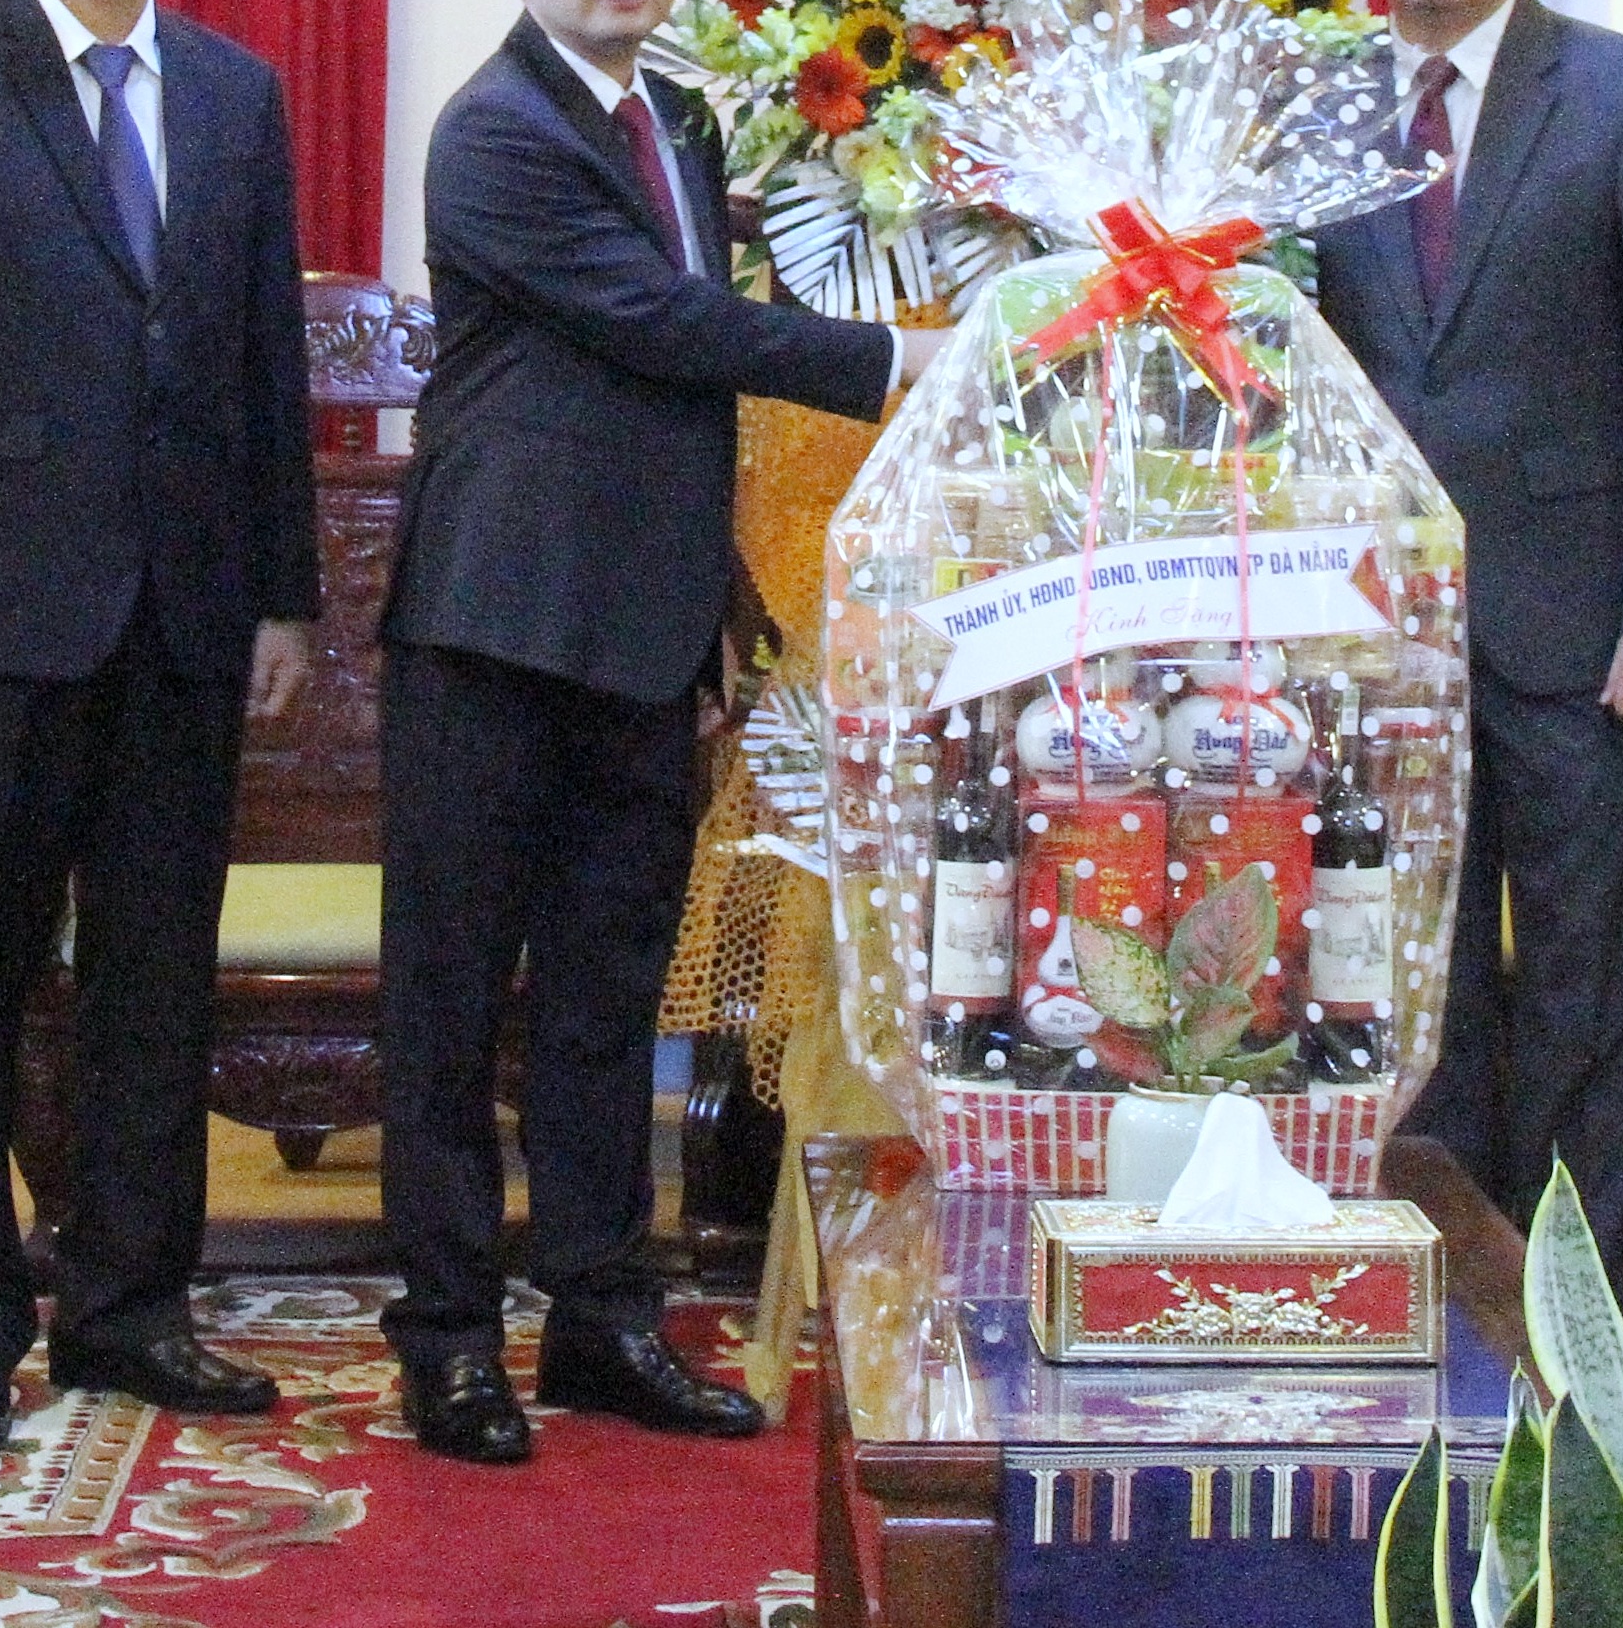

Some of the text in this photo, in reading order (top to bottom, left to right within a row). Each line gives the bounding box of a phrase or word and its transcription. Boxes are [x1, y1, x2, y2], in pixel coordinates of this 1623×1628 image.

[943, 601, 1000, 637] THÀNH
[1003, 589, 1026, 619] ỦY,
[1270, 547, 1294, 575] ĐÀ
[1299, 540, 1349, 571] NẴNG
